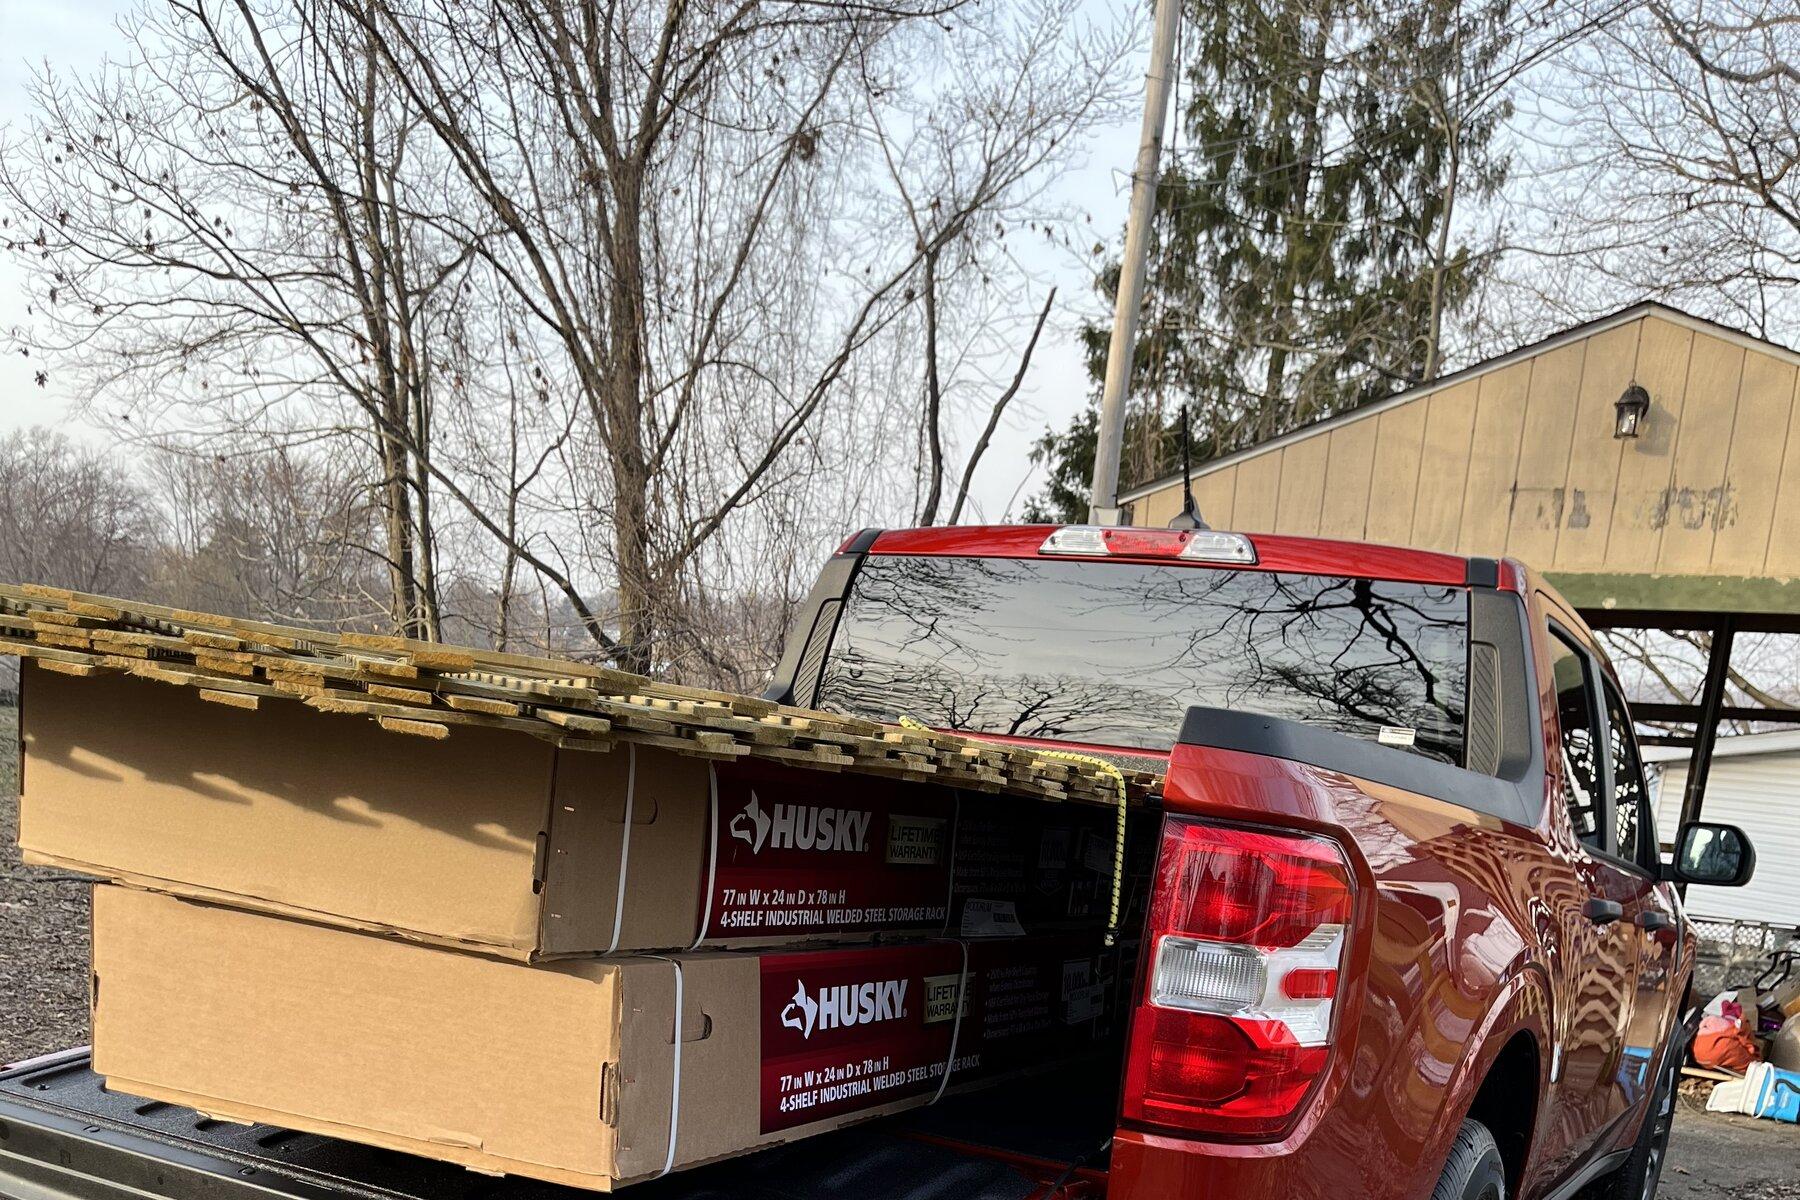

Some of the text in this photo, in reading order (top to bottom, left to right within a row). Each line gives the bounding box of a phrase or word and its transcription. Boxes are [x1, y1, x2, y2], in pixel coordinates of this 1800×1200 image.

[771, 803, 872, 852] HUSKY
[891, 825, 943, 843] LIFETIME
[890, 845, 941, 859] WARRANTY
[723, 889, 736, 906] 77
[737, 893, 747, 905] IN
[749, 889, 761, 906] W
[772, 889, 785, 905] 24
[786, 893, 796, 905] IN
[798, 889, 806, 905] D
[817, 889, 828, 905] 78
[829, 893, 837, 904] IN
[839, 889, 846, 904] H
[720, 906, 946, 928] 4-SHELF INDUSTRIAL WELDED STEEL STORAGE RACK
[819, 979, 908, 1030] HUSKY
[928, 1000, 970, 1017] WARRATY
[780, 1075, 792, 1092] 77
[794, 1076, 802, 1089] IN
[804, 1071, 814, 1087] W
[824, 1066, 835, 1083] 24
[836, 1067, 844, 1080] IN
[846, 1063, 853, 1078] D
[863, 1059, 873, 1075] 78
[874, 1060, 881, 1072] IN
[883, 1056, 889, 1070] H
[780, 1054, 981, 1112] 4-SHELF INDUSTRIAL WELDED STEEL STORGE RACK
